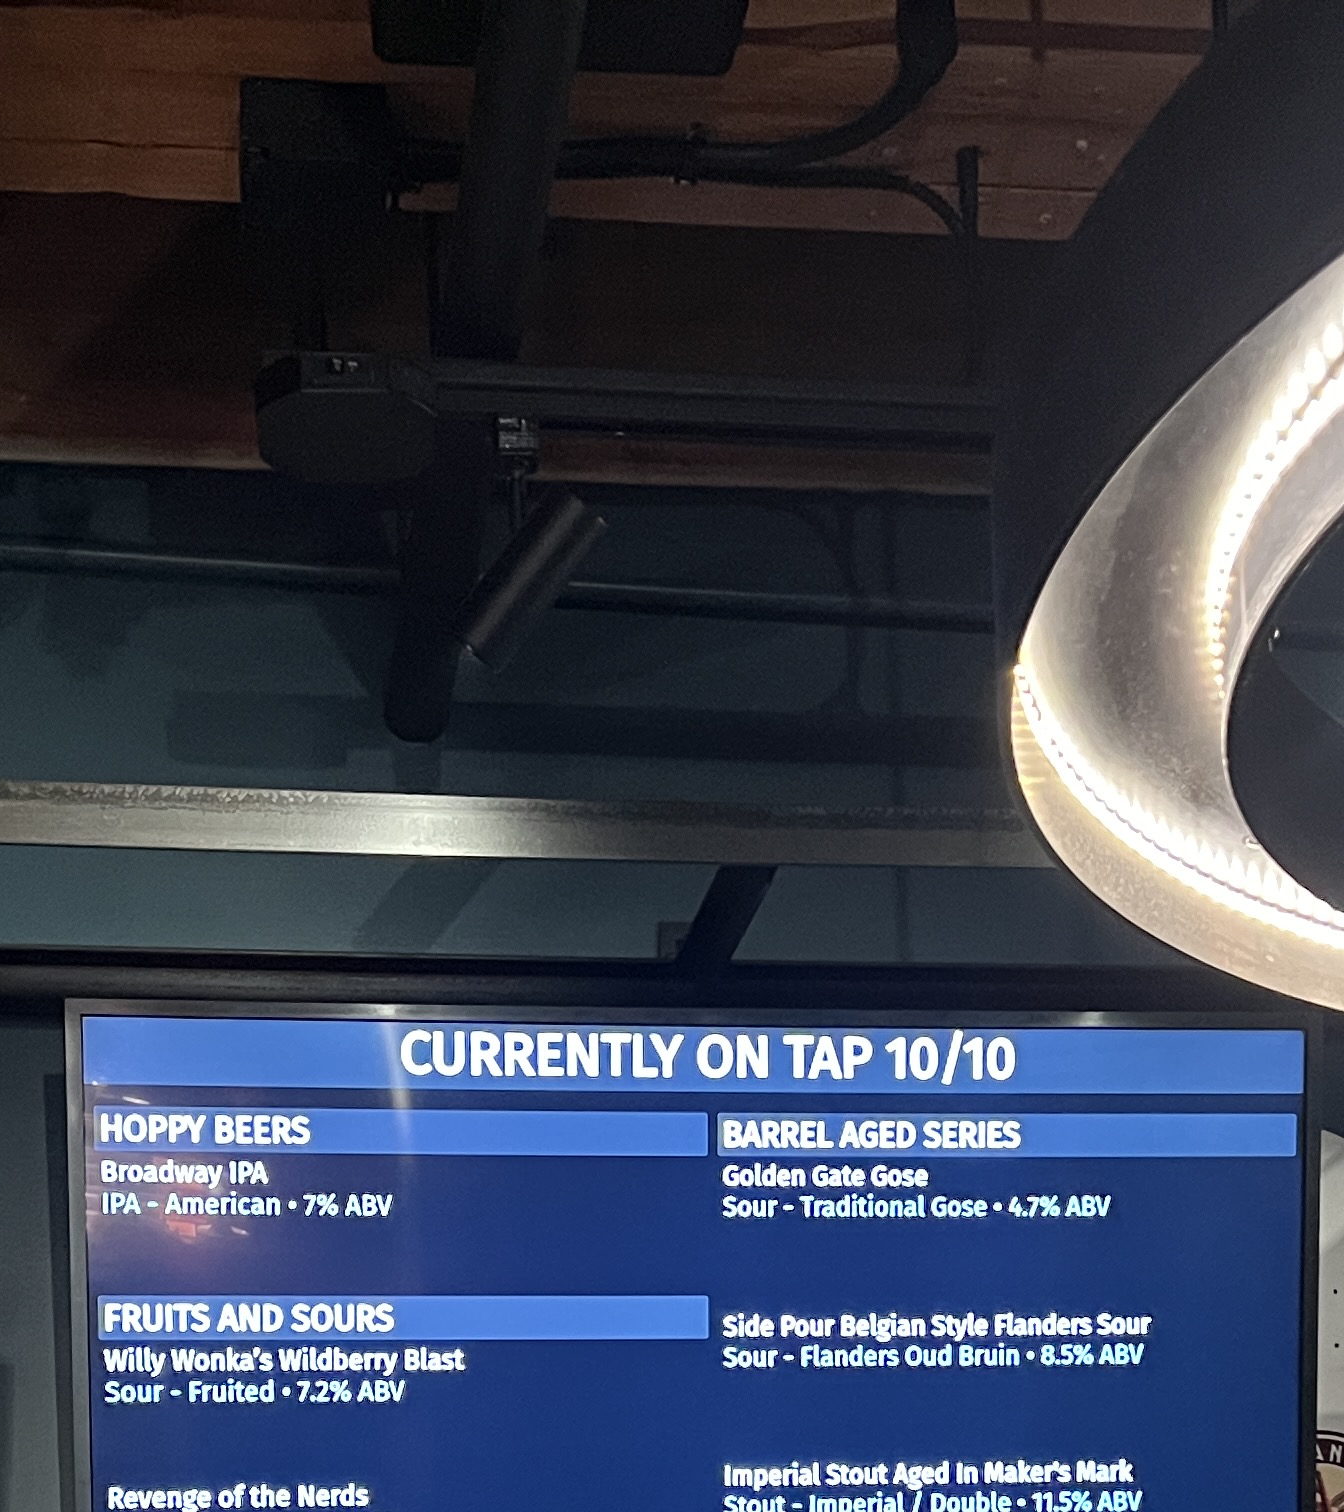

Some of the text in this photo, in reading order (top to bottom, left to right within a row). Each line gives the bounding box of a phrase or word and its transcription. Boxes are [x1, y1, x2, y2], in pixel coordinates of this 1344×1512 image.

[401, 1029, 1015, 1085] CURRENTLY ON TAP 10/10
[101, 1113, 310, 1144] HOPPY BEERS
[723, 1120, 1021, 1148] BARREL AGED SERIES
[101, 1159, 269, 1190] Broadway IPA
[722, 1163, 928, 1187] Golden Gate Gose
[103, 1192, 393, 1217] IPA American 7% ABV
[723, 1193, 1111, 1218] Sour Traditional Gose 4.7% ABV
[105, 1303, 394, 1332] FRUITS AND SOURS
[723, 1312, 1152, 1342] Side Pour Belgian Style Flanders Sour
[103, 1347, 466, 1377] Willy Wonka's Wildberry Blast
[723, 1342, 1144, 1368] Sour Flanders Oud Bruin 8.5% ABV
[105, 1378, 405, 1403] Sour Fruited 7.2% ABV
[724, 1459, 1134, 1491] Imperial Stout Aged In Maker's Mark
[218, 1483, 246, 1508] of
[249, 1484, 290, 1508] the
[298, 1483, 370, 1507] Nerds
[1031, 1491, 1092, 1512] 11.5%
[1097, 1490, 1143, 1512] ABV
